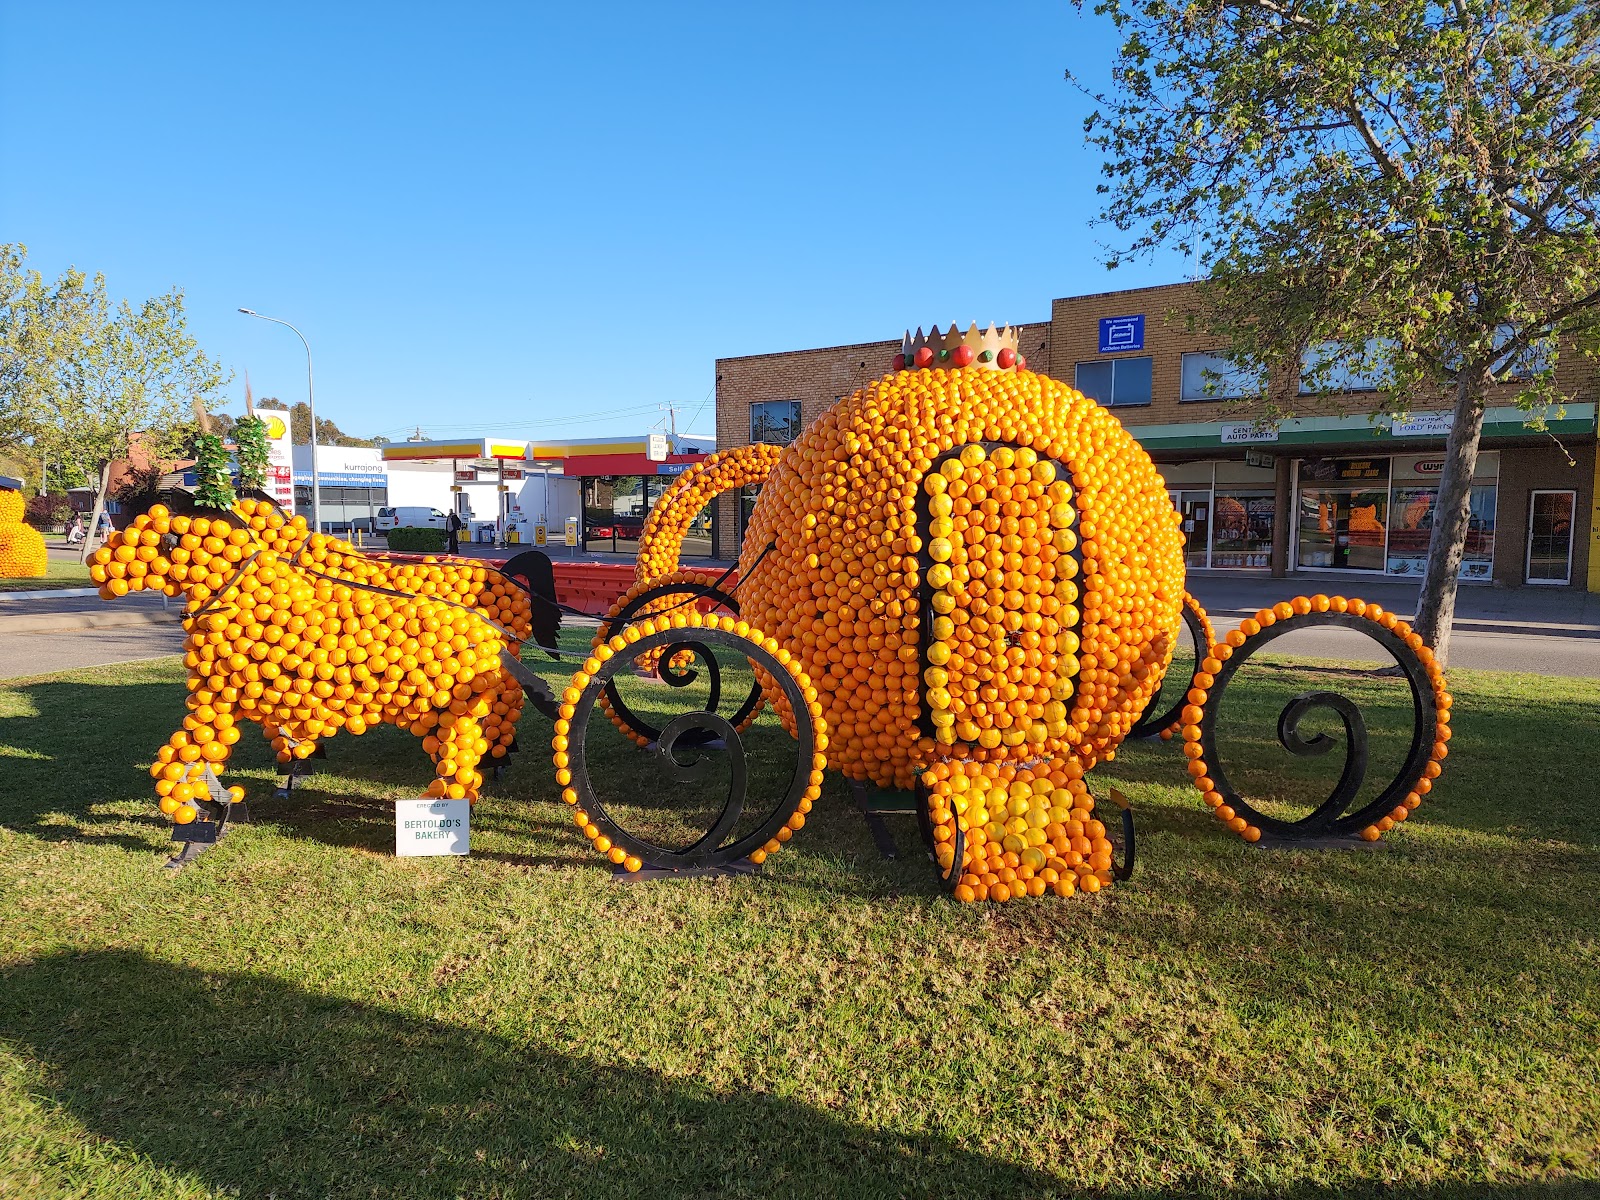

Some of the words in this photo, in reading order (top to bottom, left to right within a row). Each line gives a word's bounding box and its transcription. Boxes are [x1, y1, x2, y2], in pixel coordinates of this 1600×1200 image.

[1399, 423, 1423, 431] FORD
[344, 463, 383, 473] kurrajong
[404, 818, 462, 829] BERTOLDO'S
[415, 830, 451, 840] BAKERY
